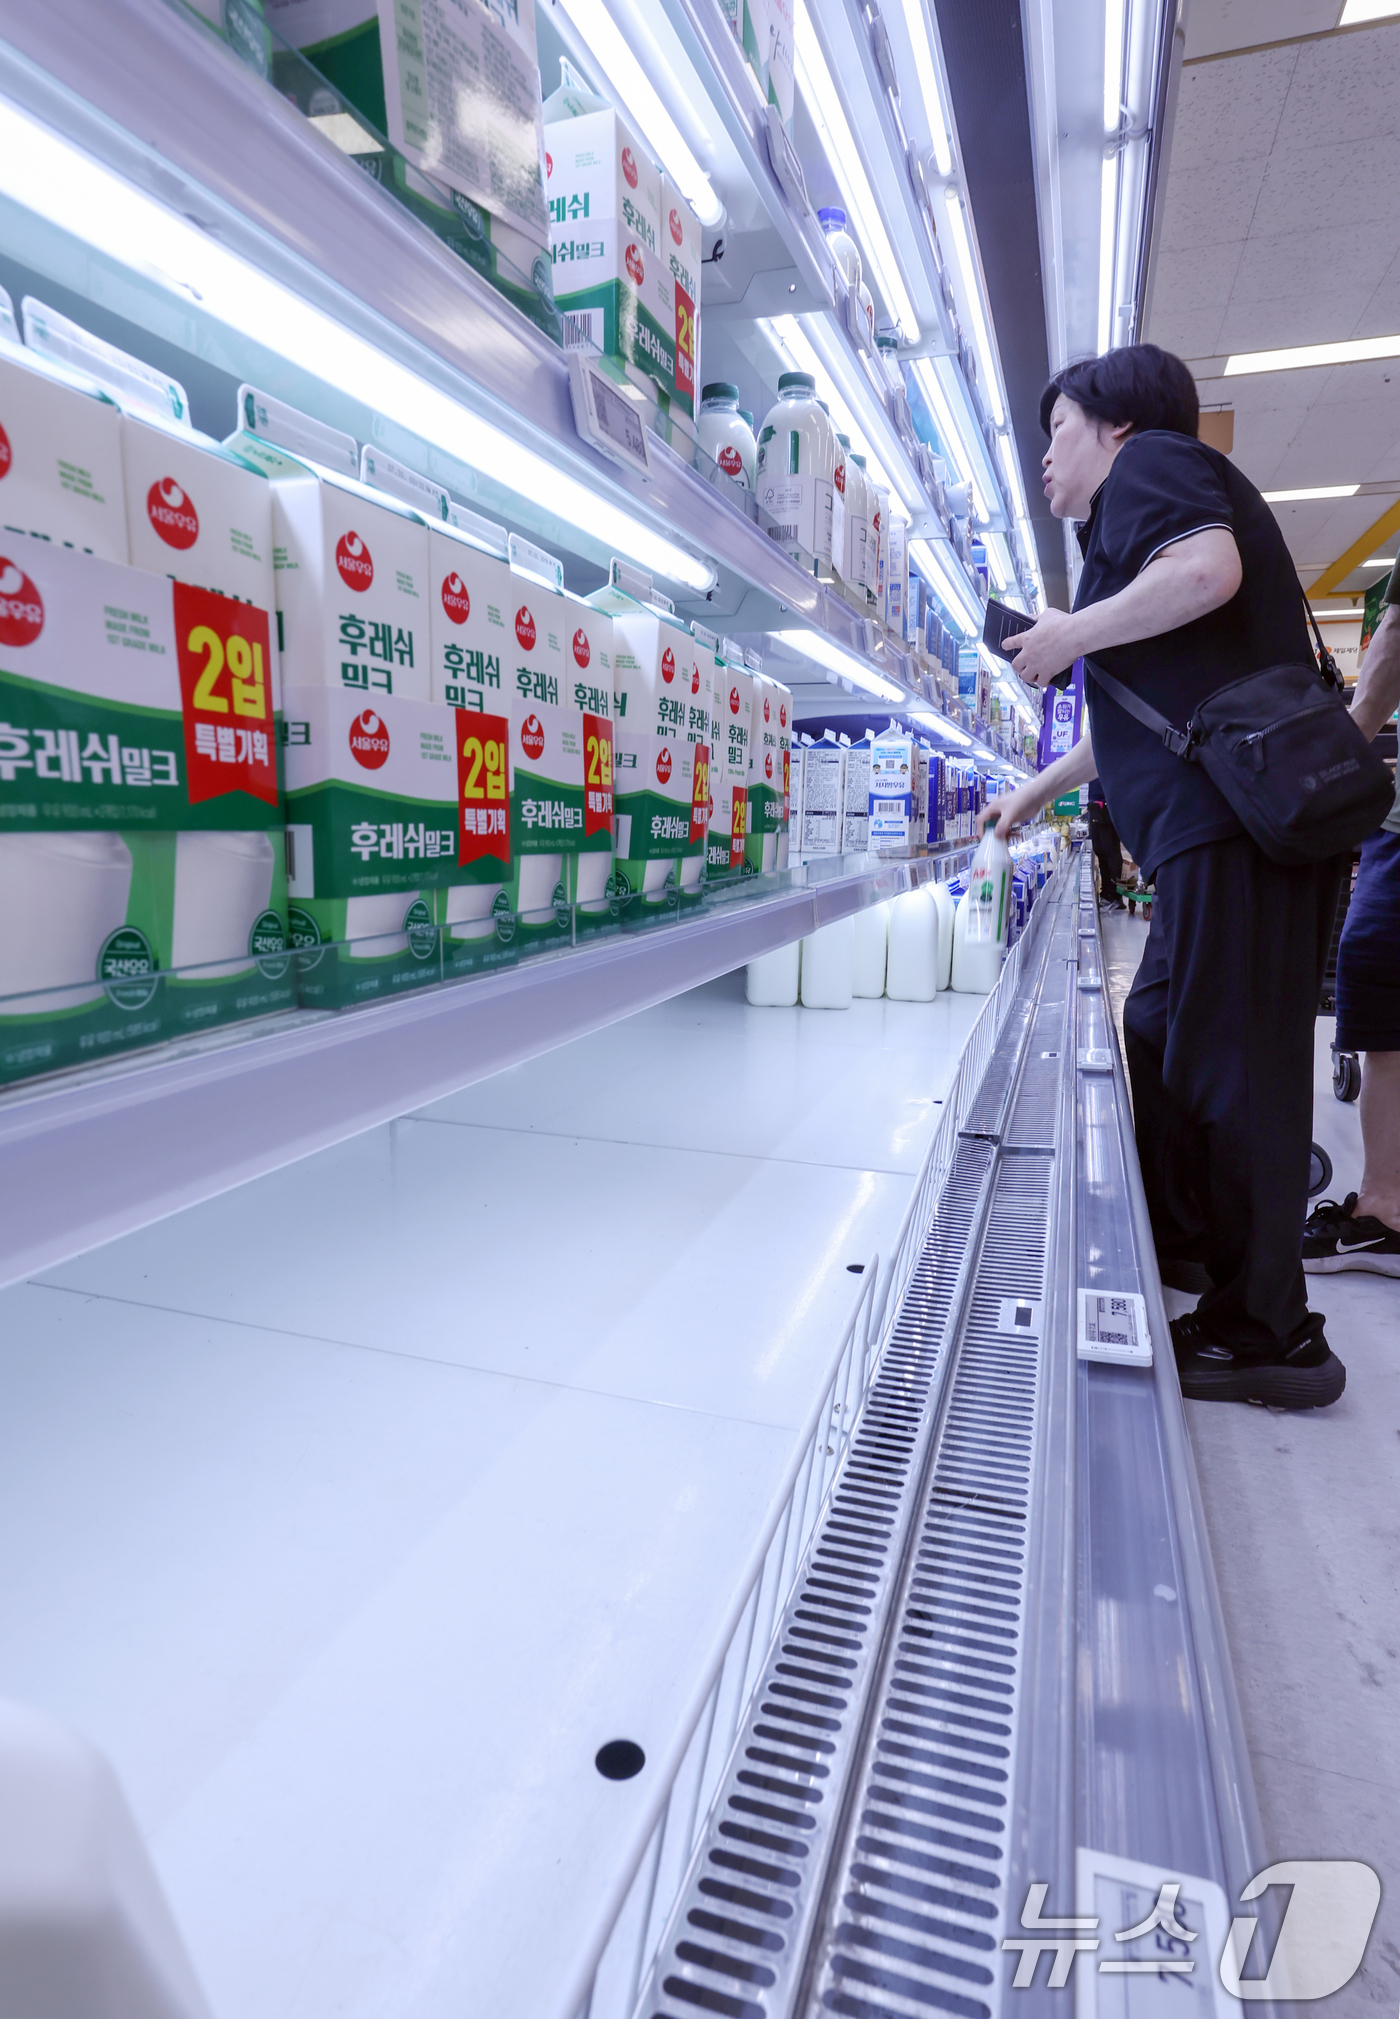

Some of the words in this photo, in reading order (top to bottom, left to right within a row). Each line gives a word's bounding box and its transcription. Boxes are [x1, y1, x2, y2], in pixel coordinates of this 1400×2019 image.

[622, 196, 655, 253] 후레쉬
[151, 504, 197, 533] 서울우유
[337, 554, 372, 579] 서울우유
[443, 593, 469, 611] 서울우유
[339, 613, 414, 668] 후레쉬
[187, 625, 266, 720] 2입
[444, 643, 501, 689] 후레쉬
[445, 684, 484, 713] 밀크
[516, 667, 558, 705] 후레쉬
[574, 682, 609, 717] 후레쉬
[658, 696, 685, 727] 후레쉬
[689, 706, 709, 733] 후레쉬
[195, 722, 268, 767] 특별기획
[352, 736, 388, 752] 서울우유
[522, 734, 544, 746] 서울우유
[728, 724, 748, 747] 후레쉬
[0, 722, 179, 786] 후레쉬밀크
[463, 736, 506, 799] 2입
[587, 736, 612, 785] 2입
[728, 746, 742, 764] 밀크
[521, 799, 583, 829] 후레쉬밀크
[588, 791, 612, 813] 특별기획
[465, 808, 506, 835] 특별기획
[650, 815, 689, 839] 후레쉬밀크
[351, 822, 455, 861] 후레쉬밀크
